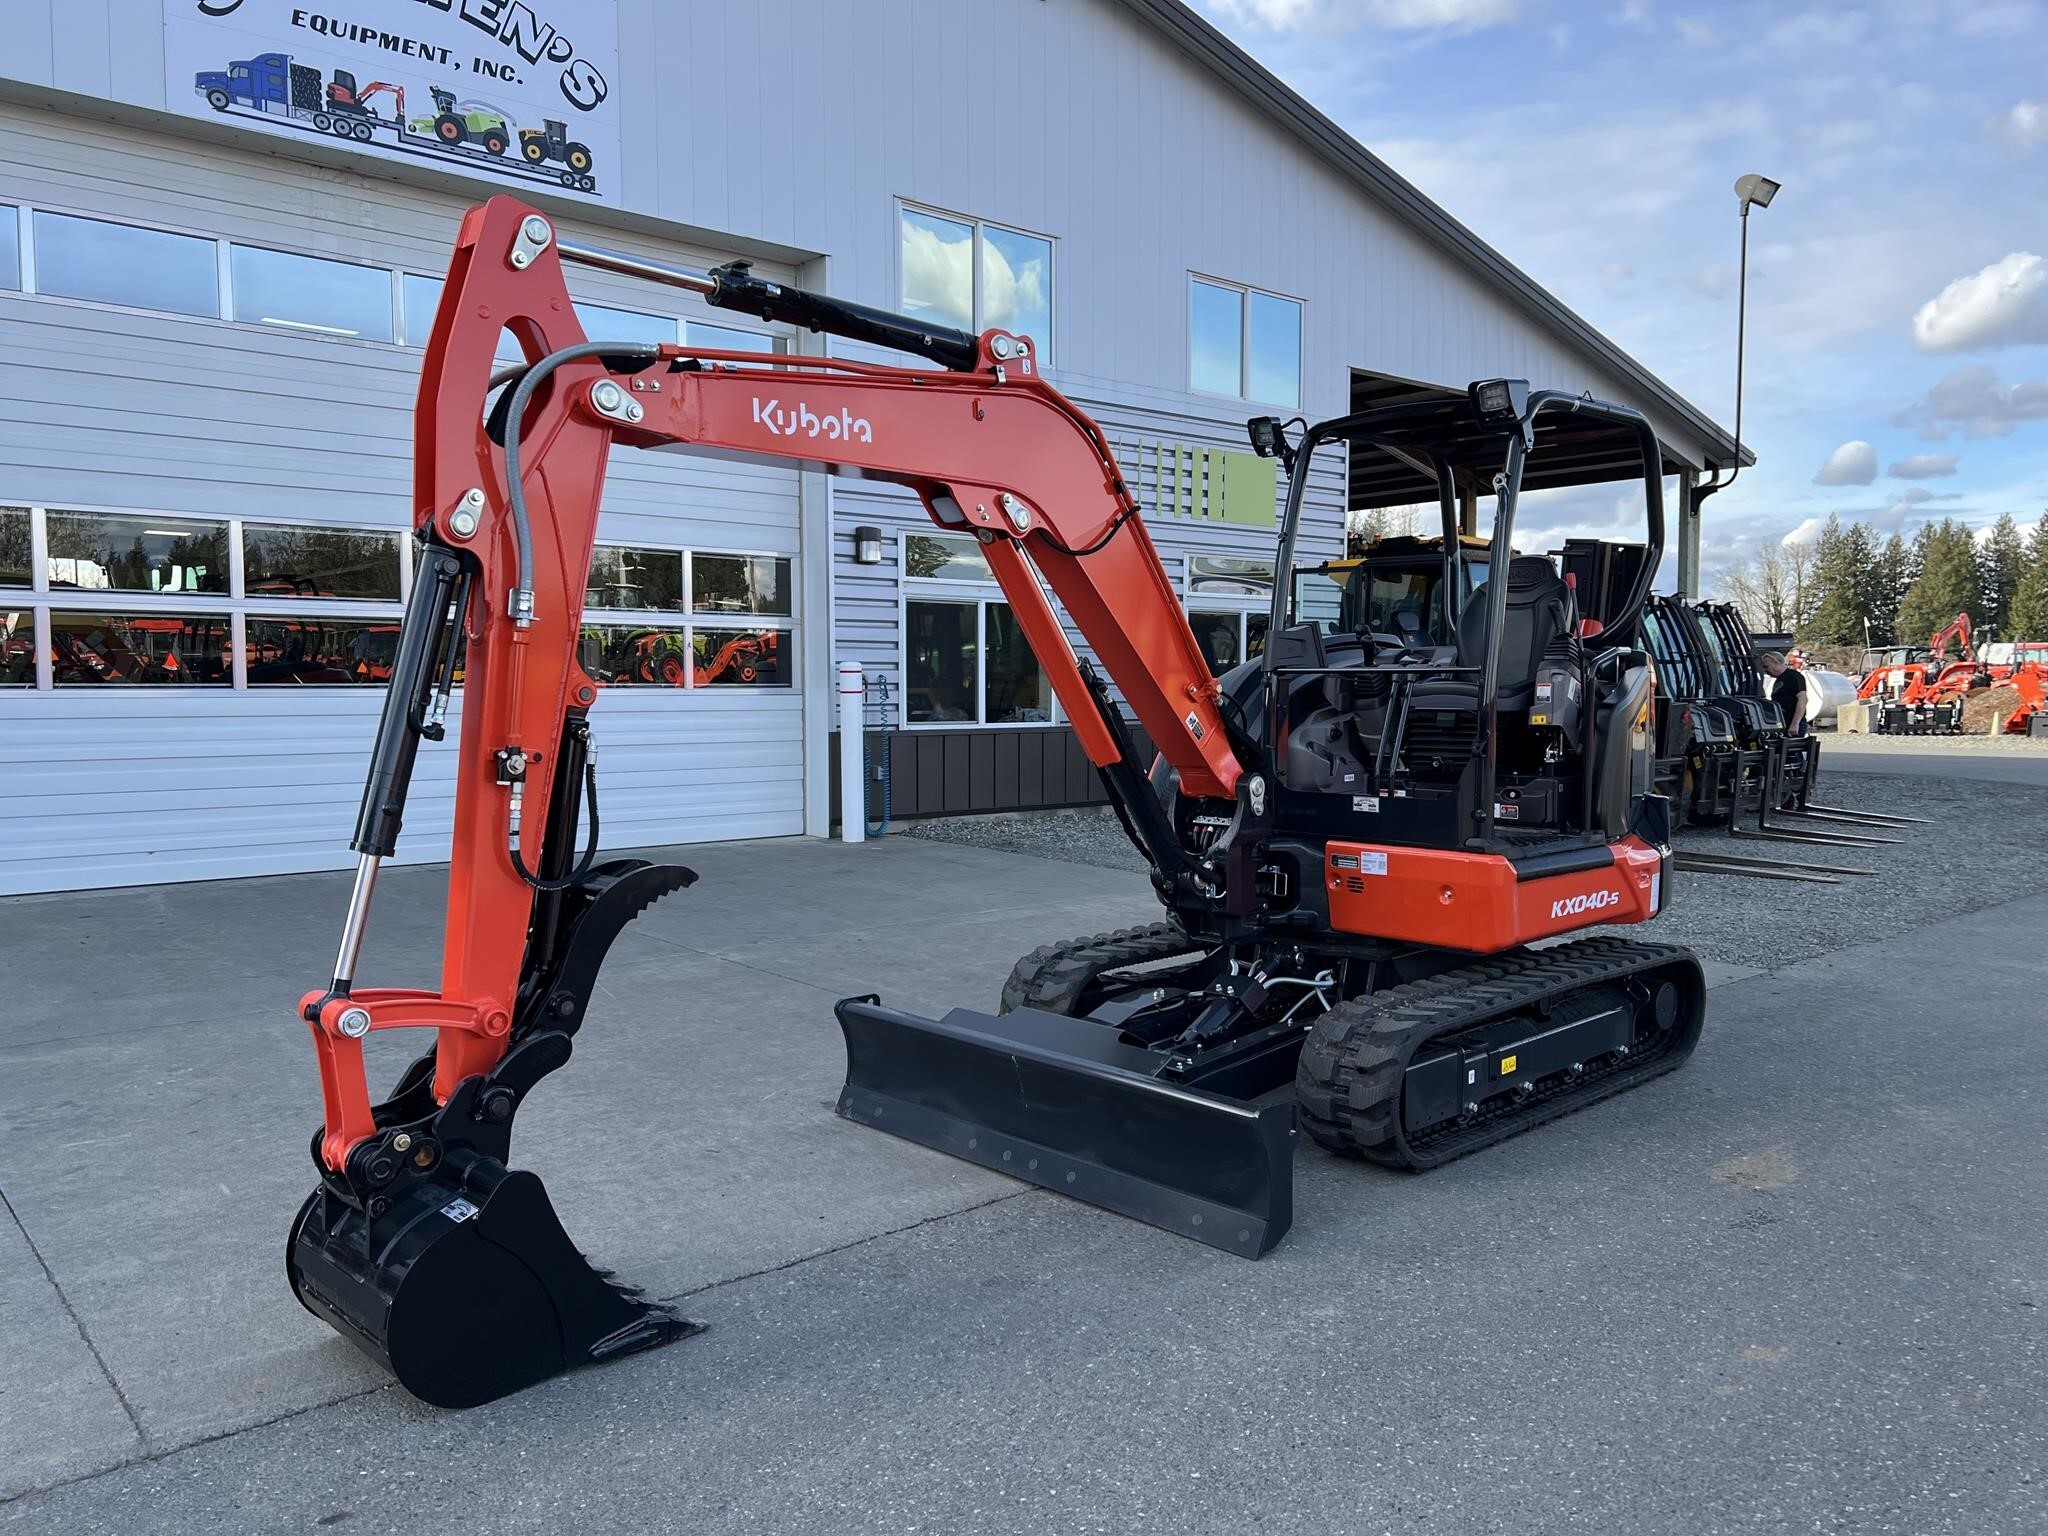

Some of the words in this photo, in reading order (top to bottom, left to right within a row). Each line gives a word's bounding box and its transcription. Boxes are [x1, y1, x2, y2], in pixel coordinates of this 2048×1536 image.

[291, 8, 461, 71] EQUIPMENT,
[473, 57, 523, 85] INC.
[752, 397, 872, 442] Kubota
